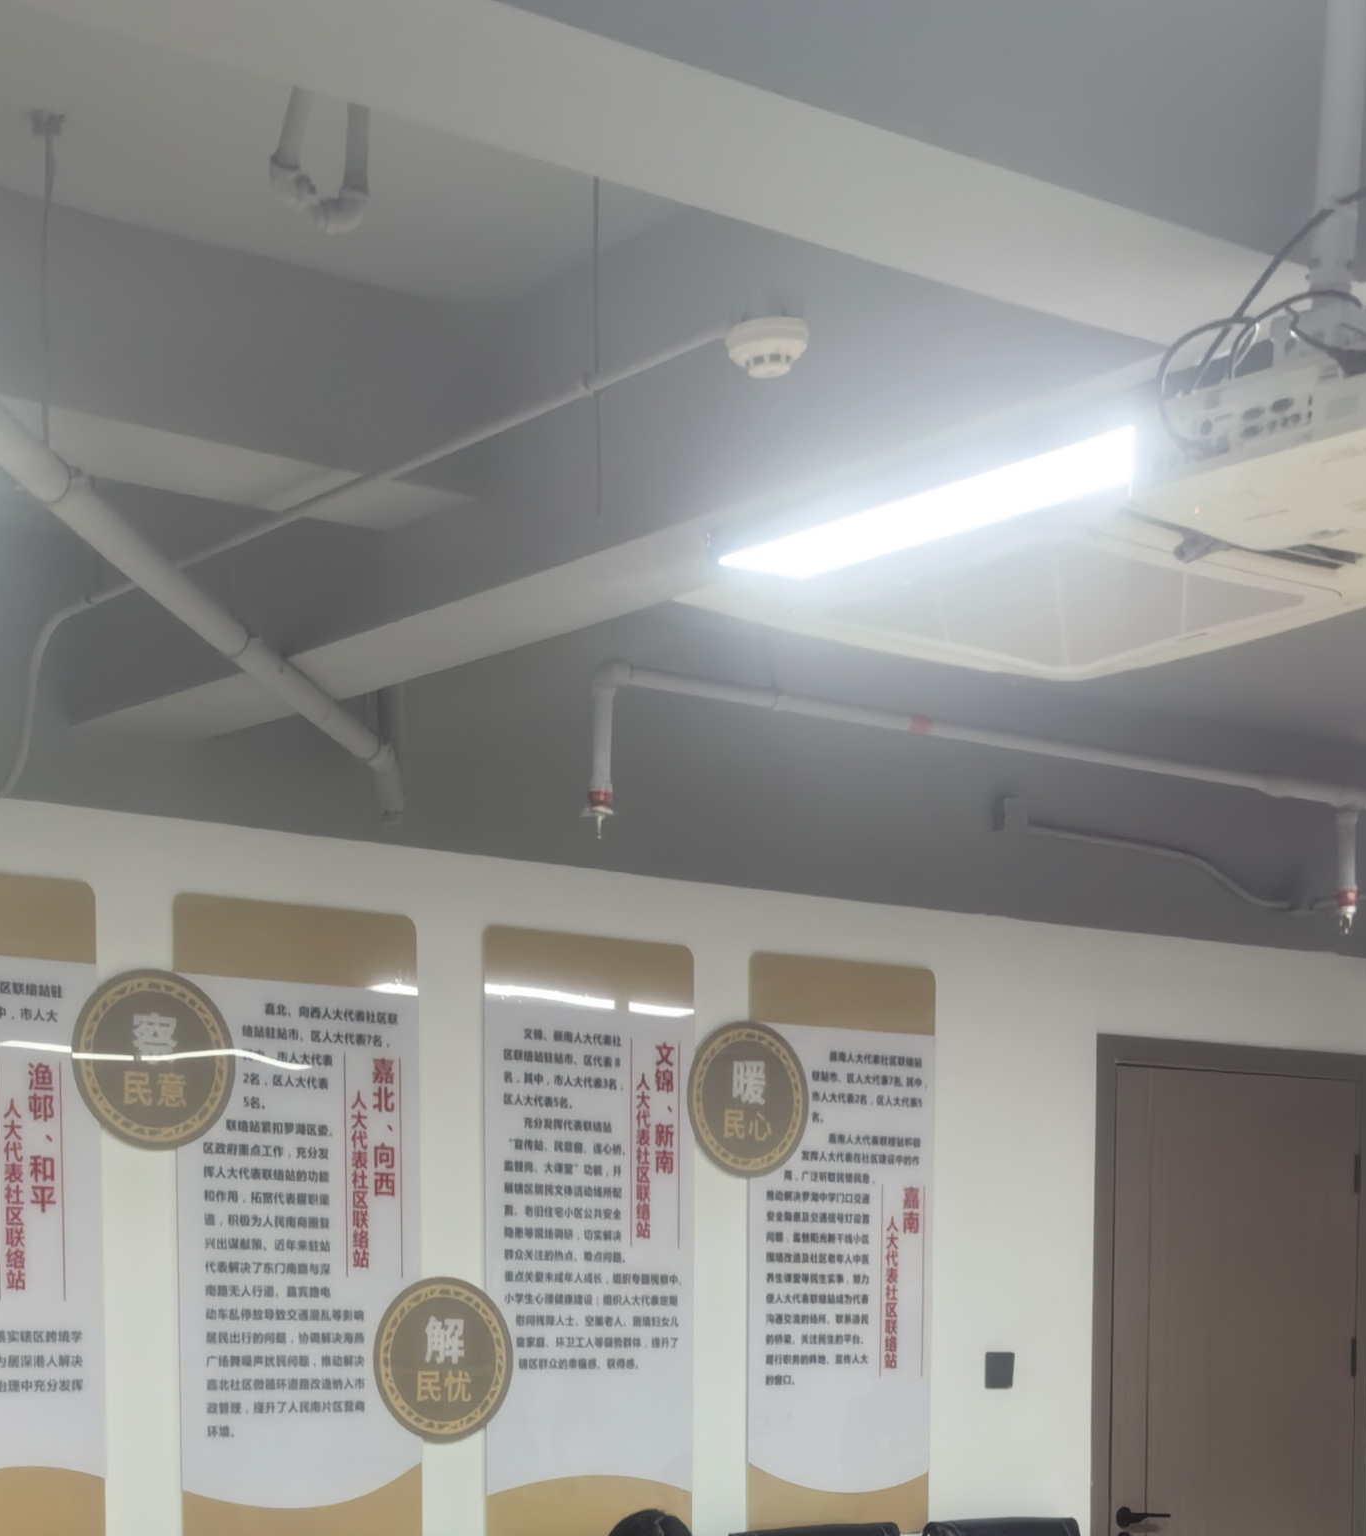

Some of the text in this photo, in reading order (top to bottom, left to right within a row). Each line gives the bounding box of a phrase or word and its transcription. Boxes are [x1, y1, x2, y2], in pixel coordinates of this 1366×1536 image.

[27, 1061, 56, 1213] 渔邨、和平
[123, 1070, 188, 1108] 民意
[371, 1057, 396, 1198] 嘉北、向西
[654, 1042, 675, 1175] 文锦、新南
[723, 1108, 772, 1142] 民心
[732, 1059, 766, 1107] 暖
[3, 1098, 26, 1291] 人大代表社区联络站
[350, 1091, 369, 1269] 人大代表社区联络站
[636, 1073, 651, 1240] 人大代表社区联络站
[902, 1186, 921, 1235] 嘉南
[424, 1315, 466, 1365] 解
[884, 1216, 899, 1369] 人大代表社区联络站
[416, 1369, 472, 1404] 民忧
